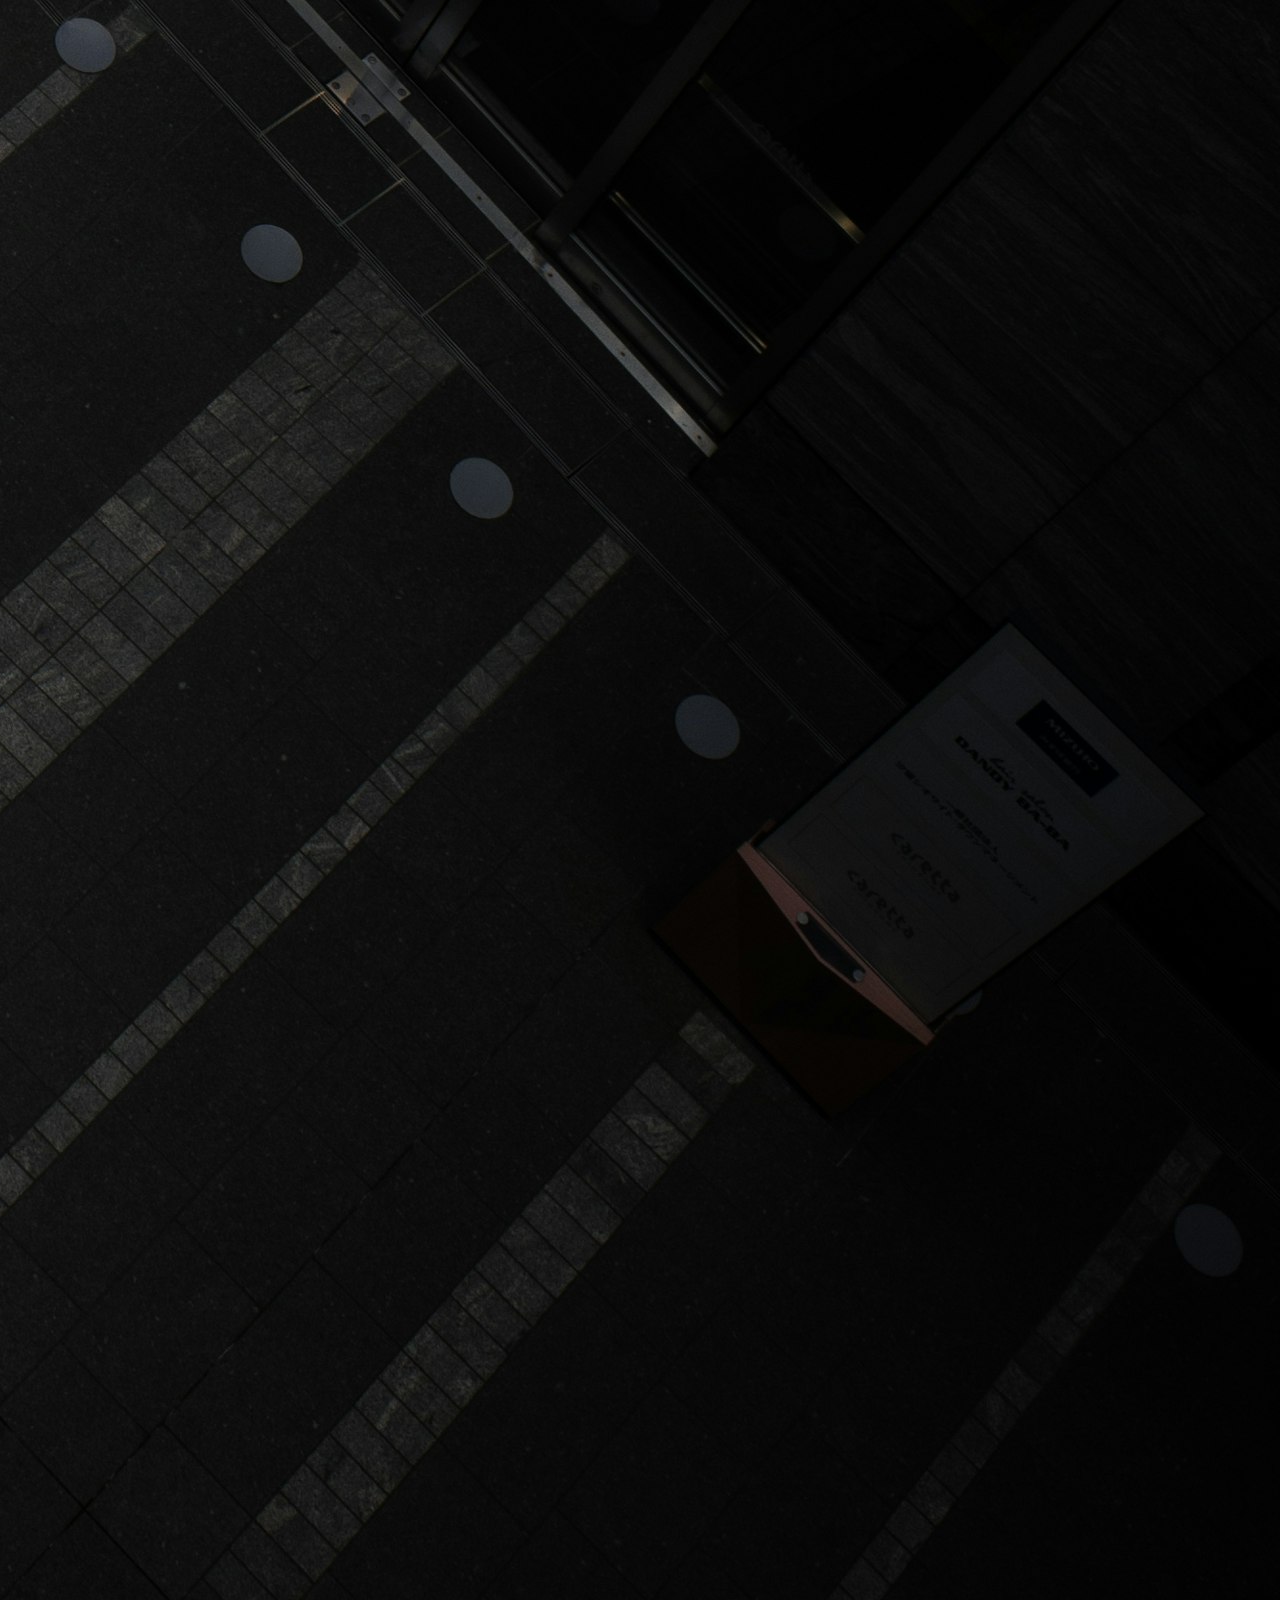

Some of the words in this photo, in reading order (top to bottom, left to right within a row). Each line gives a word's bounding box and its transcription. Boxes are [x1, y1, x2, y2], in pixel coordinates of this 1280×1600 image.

[954, 735, 1014, 792] DANDY
[1044, 717, 1100, 772] MIZUHO
[891, 832, 960, 903] caretta
[846, 869, 915, 940] caretta
